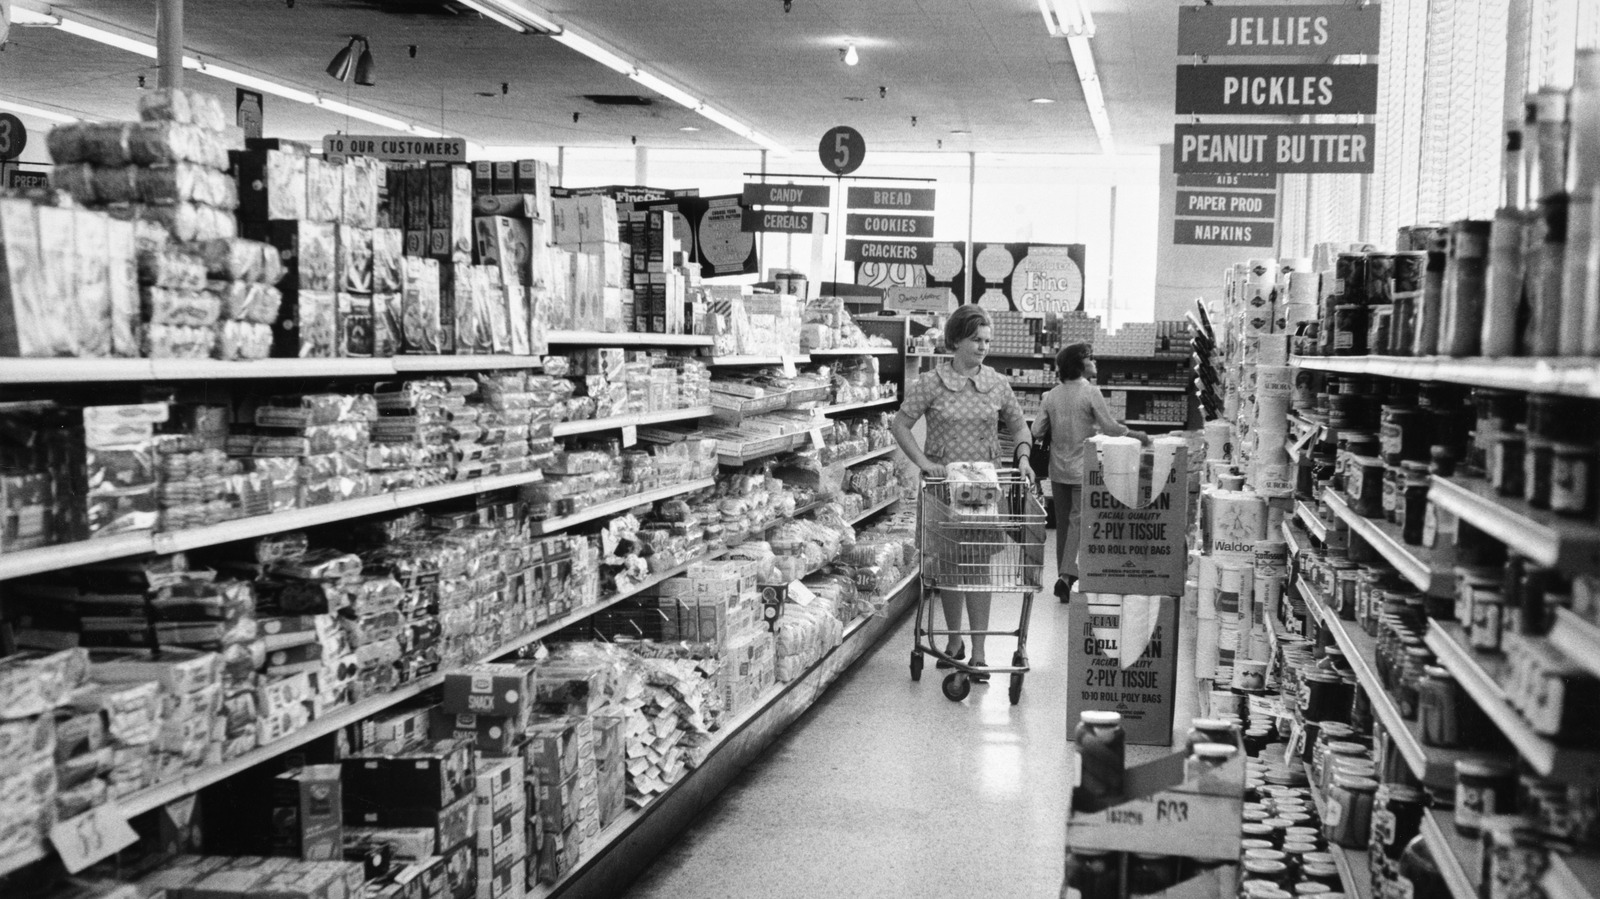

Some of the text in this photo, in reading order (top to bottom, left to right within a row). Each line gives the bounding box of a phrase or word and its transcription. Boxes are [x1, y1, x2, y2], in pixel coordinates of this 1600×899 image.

[1227, 16, 1329, 46] JELLIES
[1223, 76, 1334, 106] PICKLES
[0, 119, 12, 153] 3
[329, 139, 460, 156] TO OUR CUSTOMERS
[833, 133, 850, 168] 5
[1181, 134, 1367, 163] PEANUT BUTTER
[1216, 175, 1239, 185] AIDS
[769, 187, 804, 202] CANDY
[873, 191, 912, 206] BREAD
[1188, 195, 1263, 212] PAPER PROD
[763, 214, 809, 230] CEREALS
[864, 217, 916, 233] COOKIES
[1194, 224, 1253, 242] NAPKINS
[861, 243, 918, 260] CRACKERS
[1024, 270, 1068, 292] Fine
[1020, 291, 1070, 313] China
[1090, 490, 1170, 510] GEOAN
[1098, 511, 1162, 521] FACIAL QUALITY
[1092, 522, 1167, 541] 2-PLY TISSUE
[1107, 544, 1127, 555] ROLL
[1129, 545, 1149, 555] POLY
[1151, 545, 1171, 556] BAGS
[1091, 616, 1119, 627] CIAL
[1086, 668, 1158, 689] 2-PLY TISSUE
[468, 695, 495, 710] SNACK
[1099, 692, 1118, 702] ROLL
[1121, 693, 1141, 703] POLY
[1142, 693, 1162, 704] BAGS
